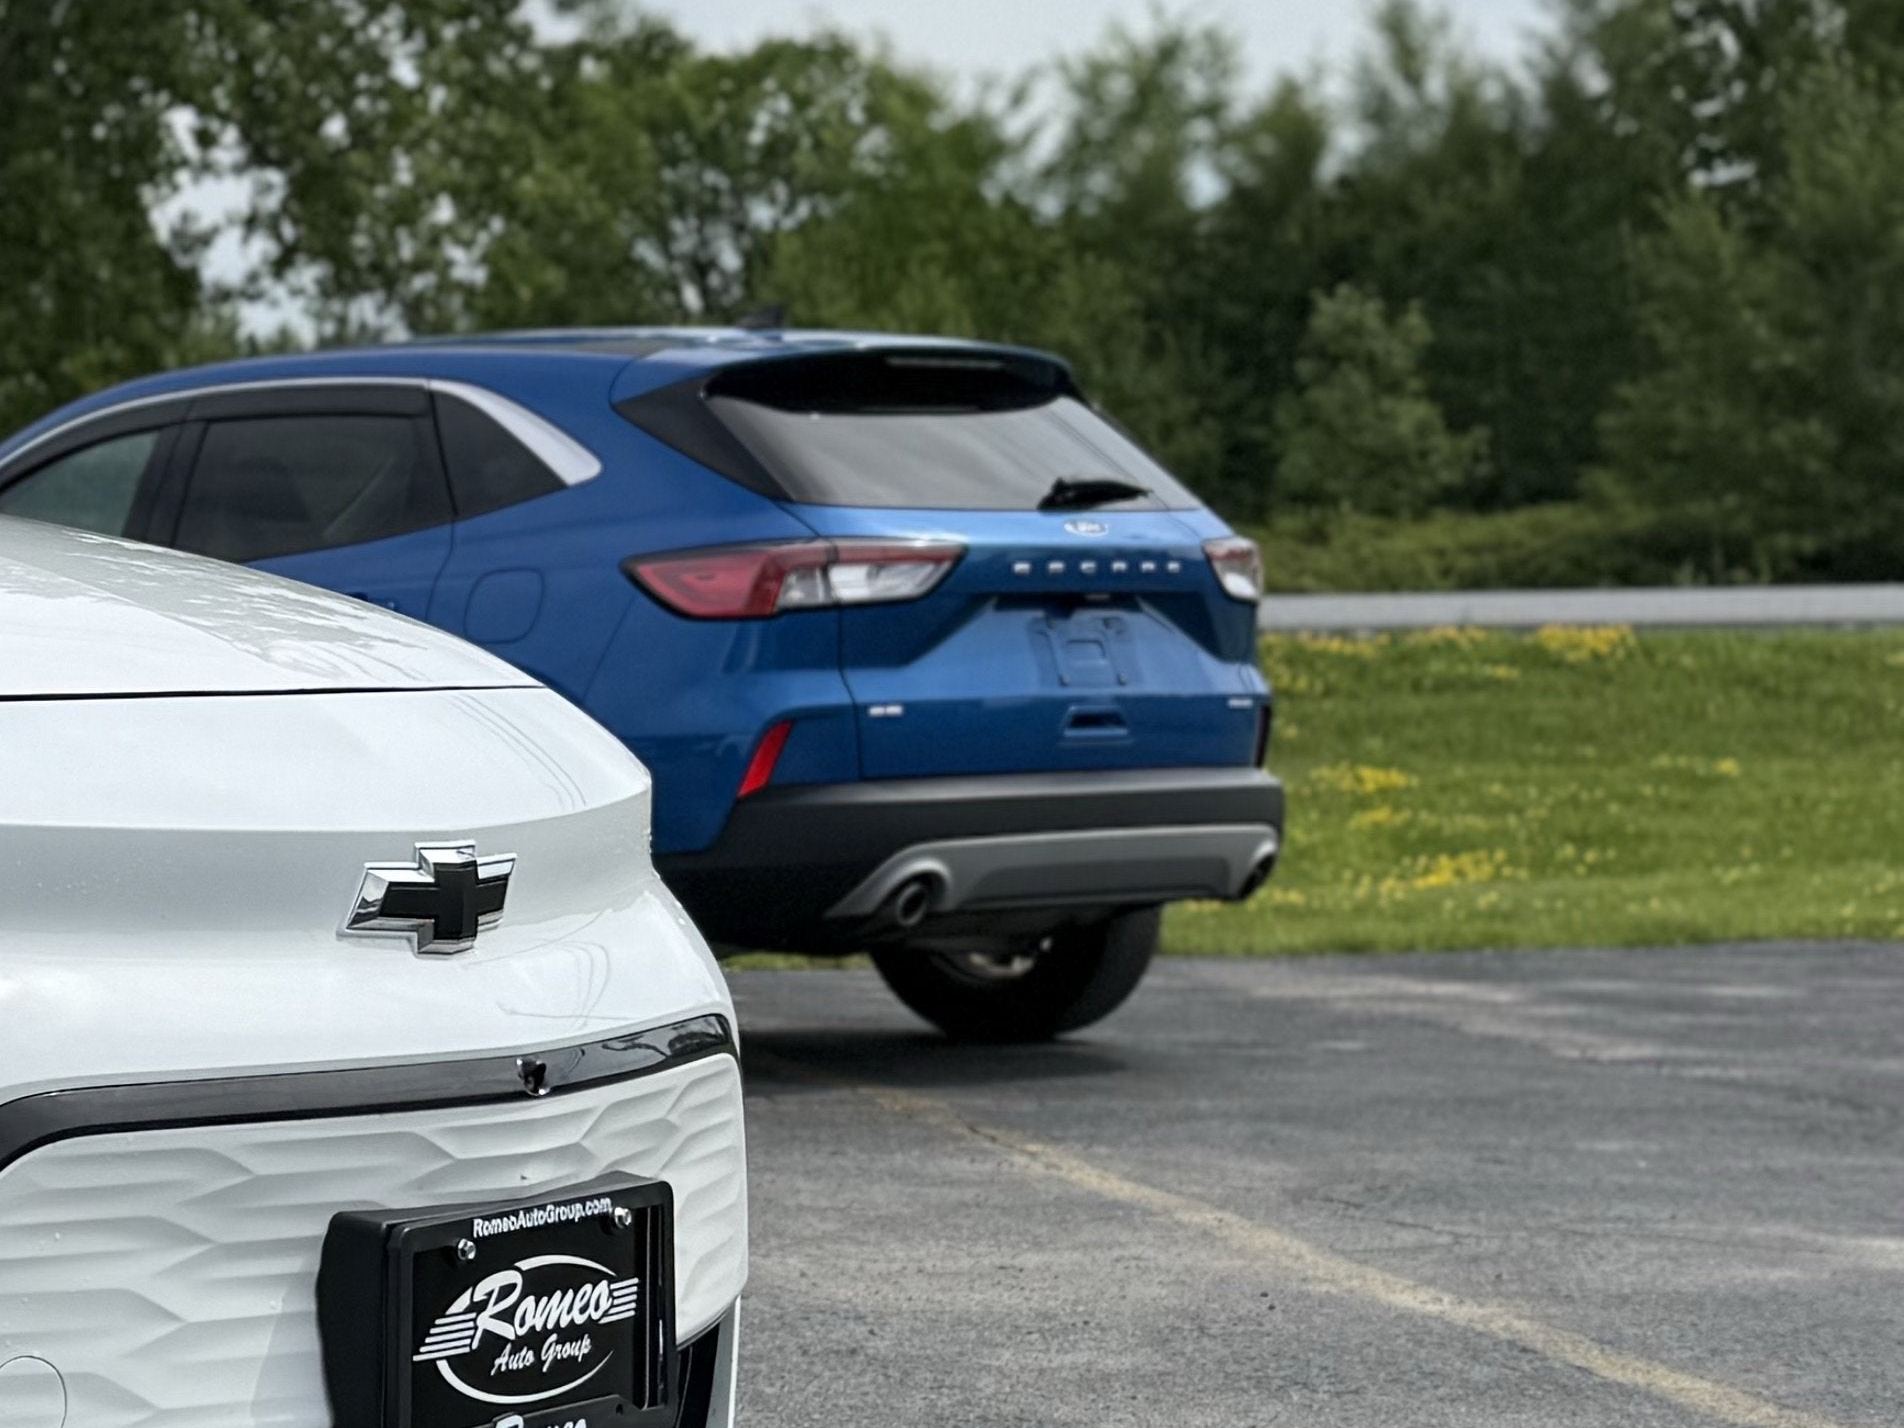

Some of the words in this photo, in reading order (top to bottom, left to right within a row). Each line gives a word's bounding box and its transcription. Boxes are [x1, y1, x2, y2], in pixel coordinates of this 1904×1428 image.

[472, 1197, 614, 1239] RomeoAutoGroup.com
[471, 1269, 613, 1350] Romeo
[490, 1341, 535, 1377] Auto
[540, 1332, 592, 1373] Group
